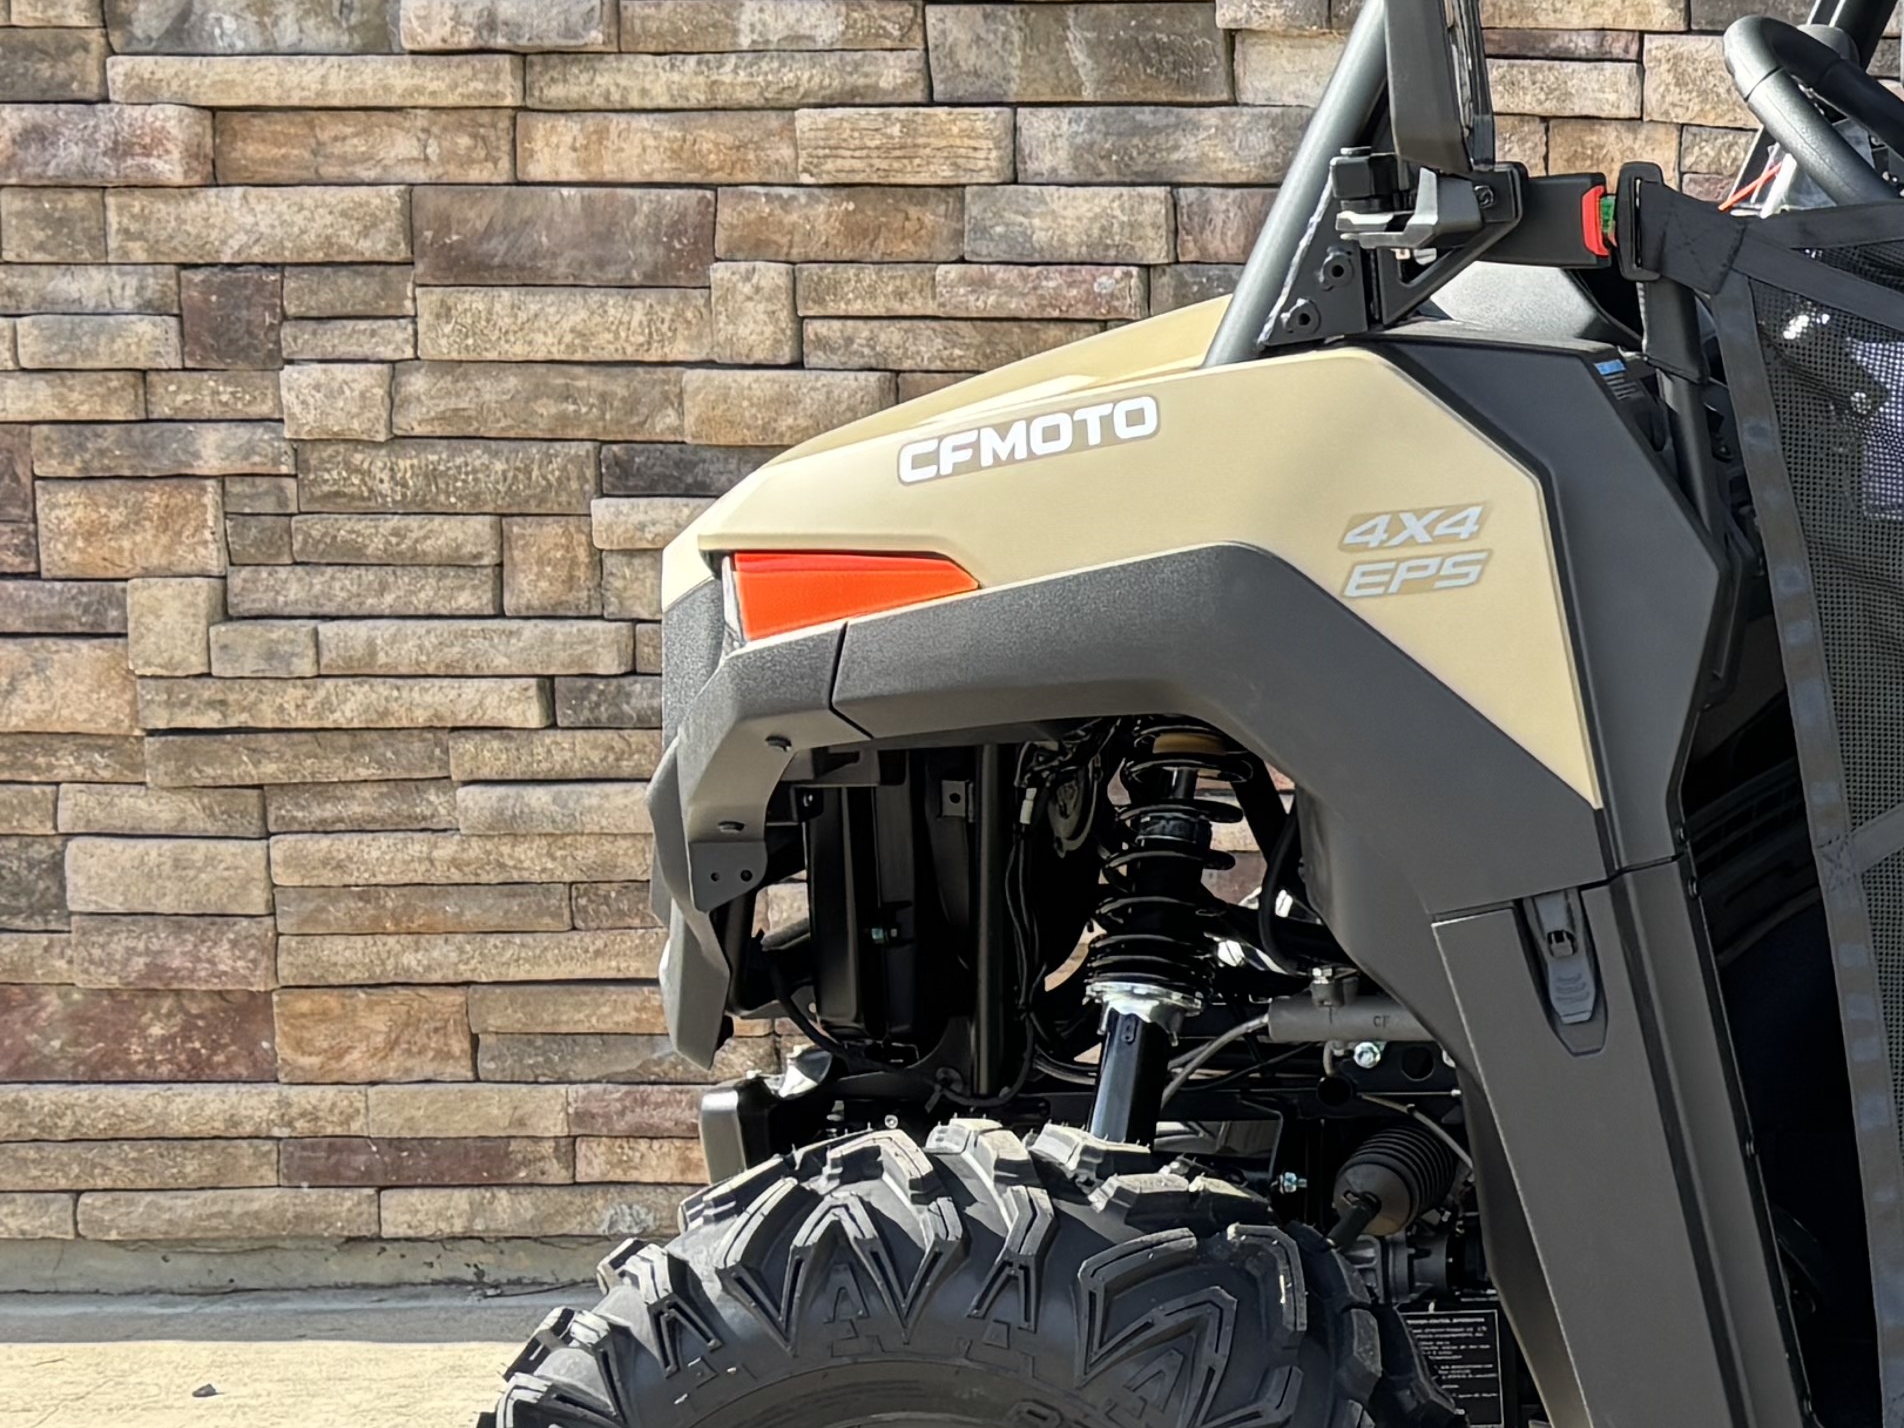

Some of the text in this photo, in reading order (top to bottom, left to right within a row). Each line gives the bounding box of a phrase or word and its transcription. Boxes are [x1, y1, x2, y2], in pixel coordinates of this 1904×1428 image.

[898, 395, 1158, 484] CFMOTO
[1343, 505, 1484, 548] 4X4
[1343, 551, 1490, 598] EPS
